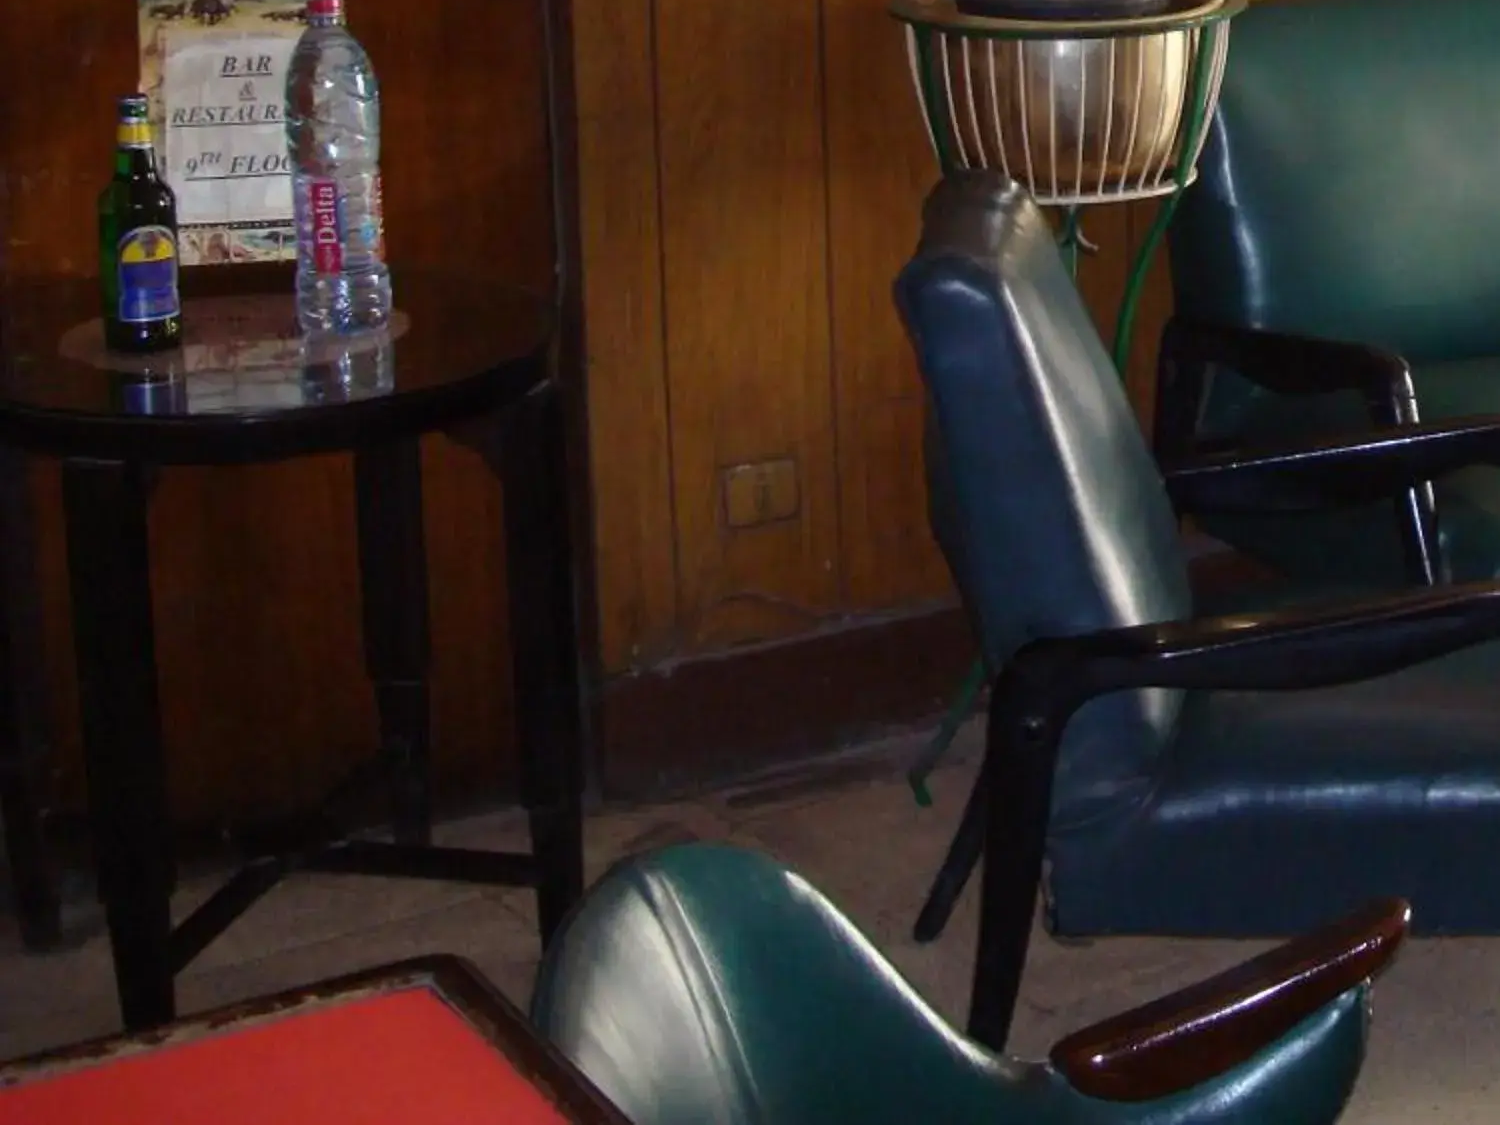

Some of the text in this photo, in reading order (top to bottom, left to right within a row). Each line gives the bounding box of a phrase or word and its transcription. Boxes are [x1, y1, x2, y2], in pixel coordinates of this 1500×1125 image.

[221, 54, 271, 73] BAR
[239, 80, 253, 96] &
[172, 104, 283, 123] RESTAUR
[186, 151, 222, 174] 9TH
[316, 186, 337, 244] Delta
